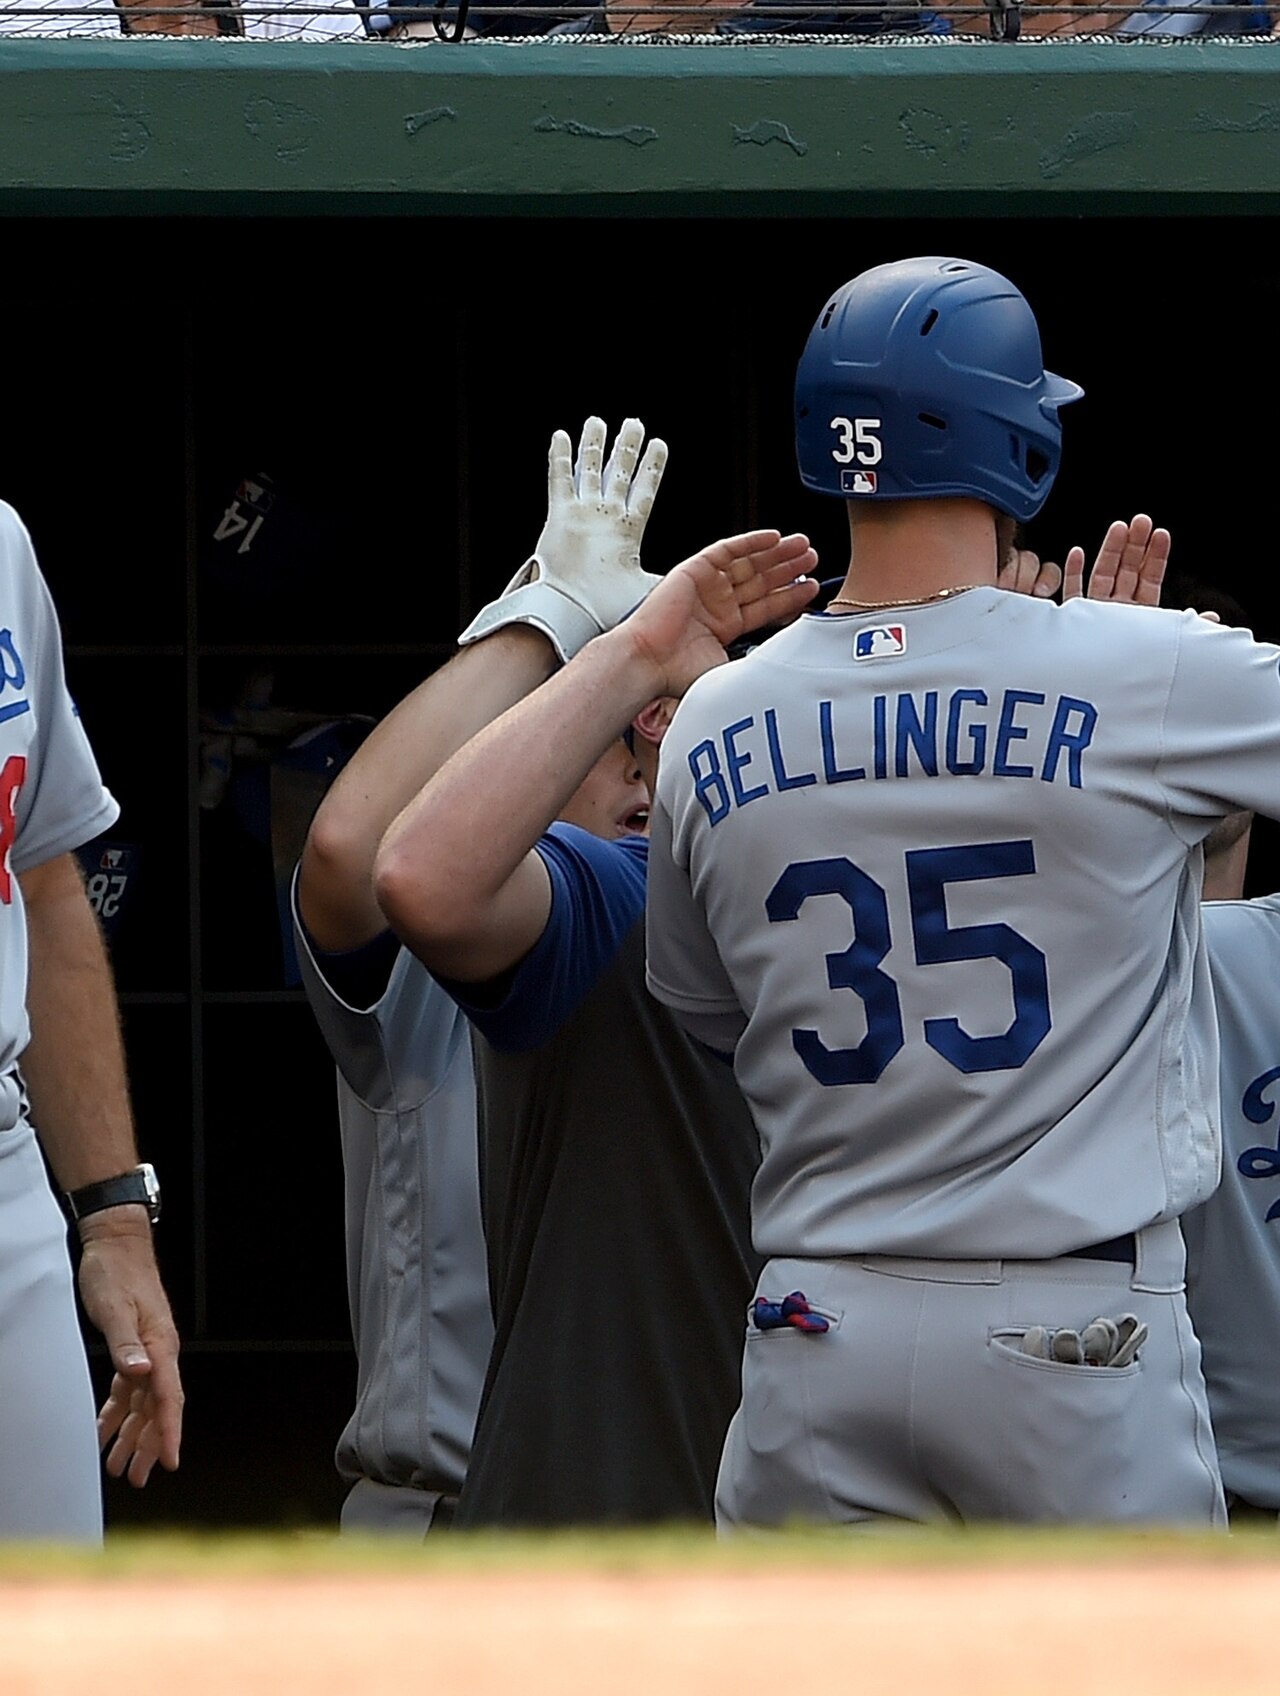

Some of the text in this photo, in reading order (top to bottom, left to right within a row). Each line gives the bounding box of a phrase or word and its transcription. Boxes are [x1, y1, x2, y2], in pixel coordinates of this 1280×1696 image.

[830, 416, 882, 465] 35
[213, 499, 264, 554] 14
[688, 688, 1099, 829] BELLINGER
[87, 873, 128, 918] 28
[765, 839, 1053, 1087] 35
